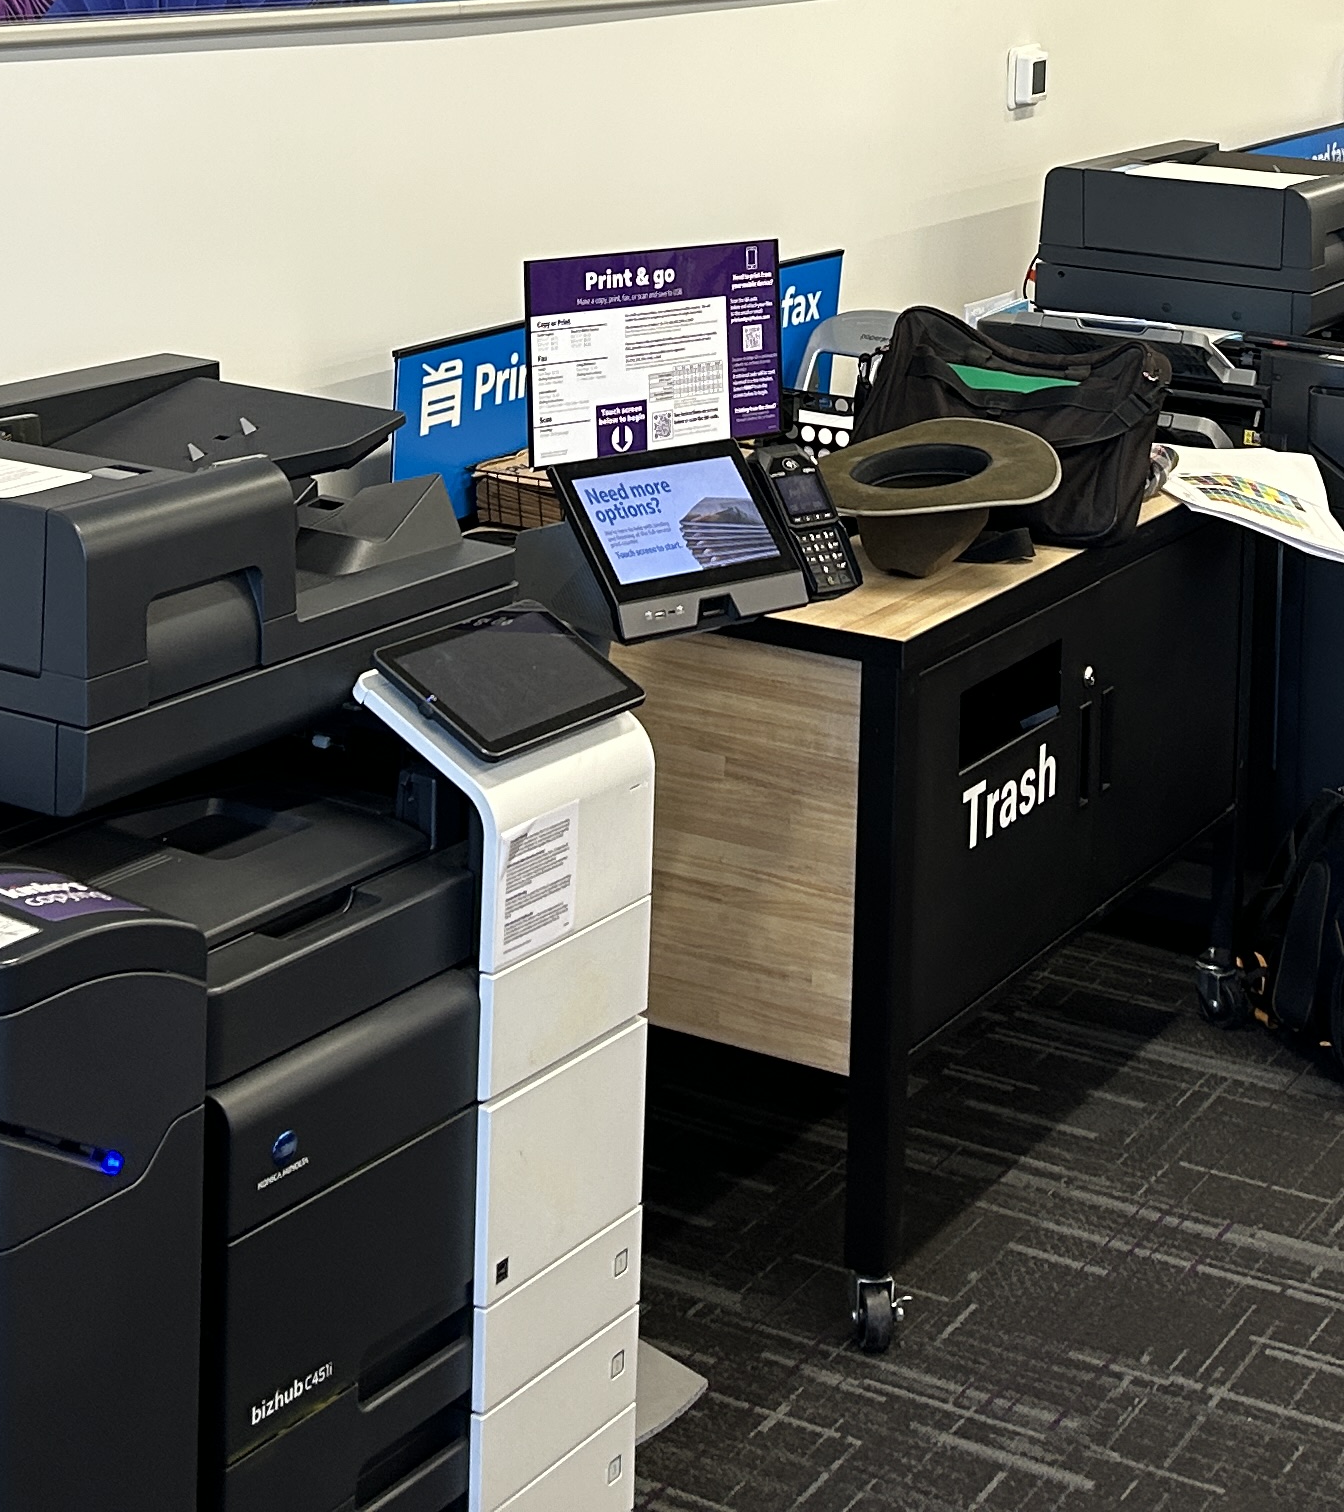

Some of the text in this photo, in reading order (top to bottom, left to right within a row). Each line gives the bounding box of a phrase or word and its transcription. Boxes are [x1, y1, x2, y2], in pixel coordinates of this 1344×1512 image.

[585, 266, 676, 291] Print & go
[781, 285, 822, 328] fax
[537, 320, 550, 328] Copy
[473, 352, 527, 411] Pri
[599, 413, 645, 425] below to begin
[600, 405, 642, 417] Touch screen
[584, 481, 671, 505] Need more
[596, 497, 662, 526] options?
[962, 743, 1056, 849] Trash
[251, 1379, 303, 1425] bizhub
